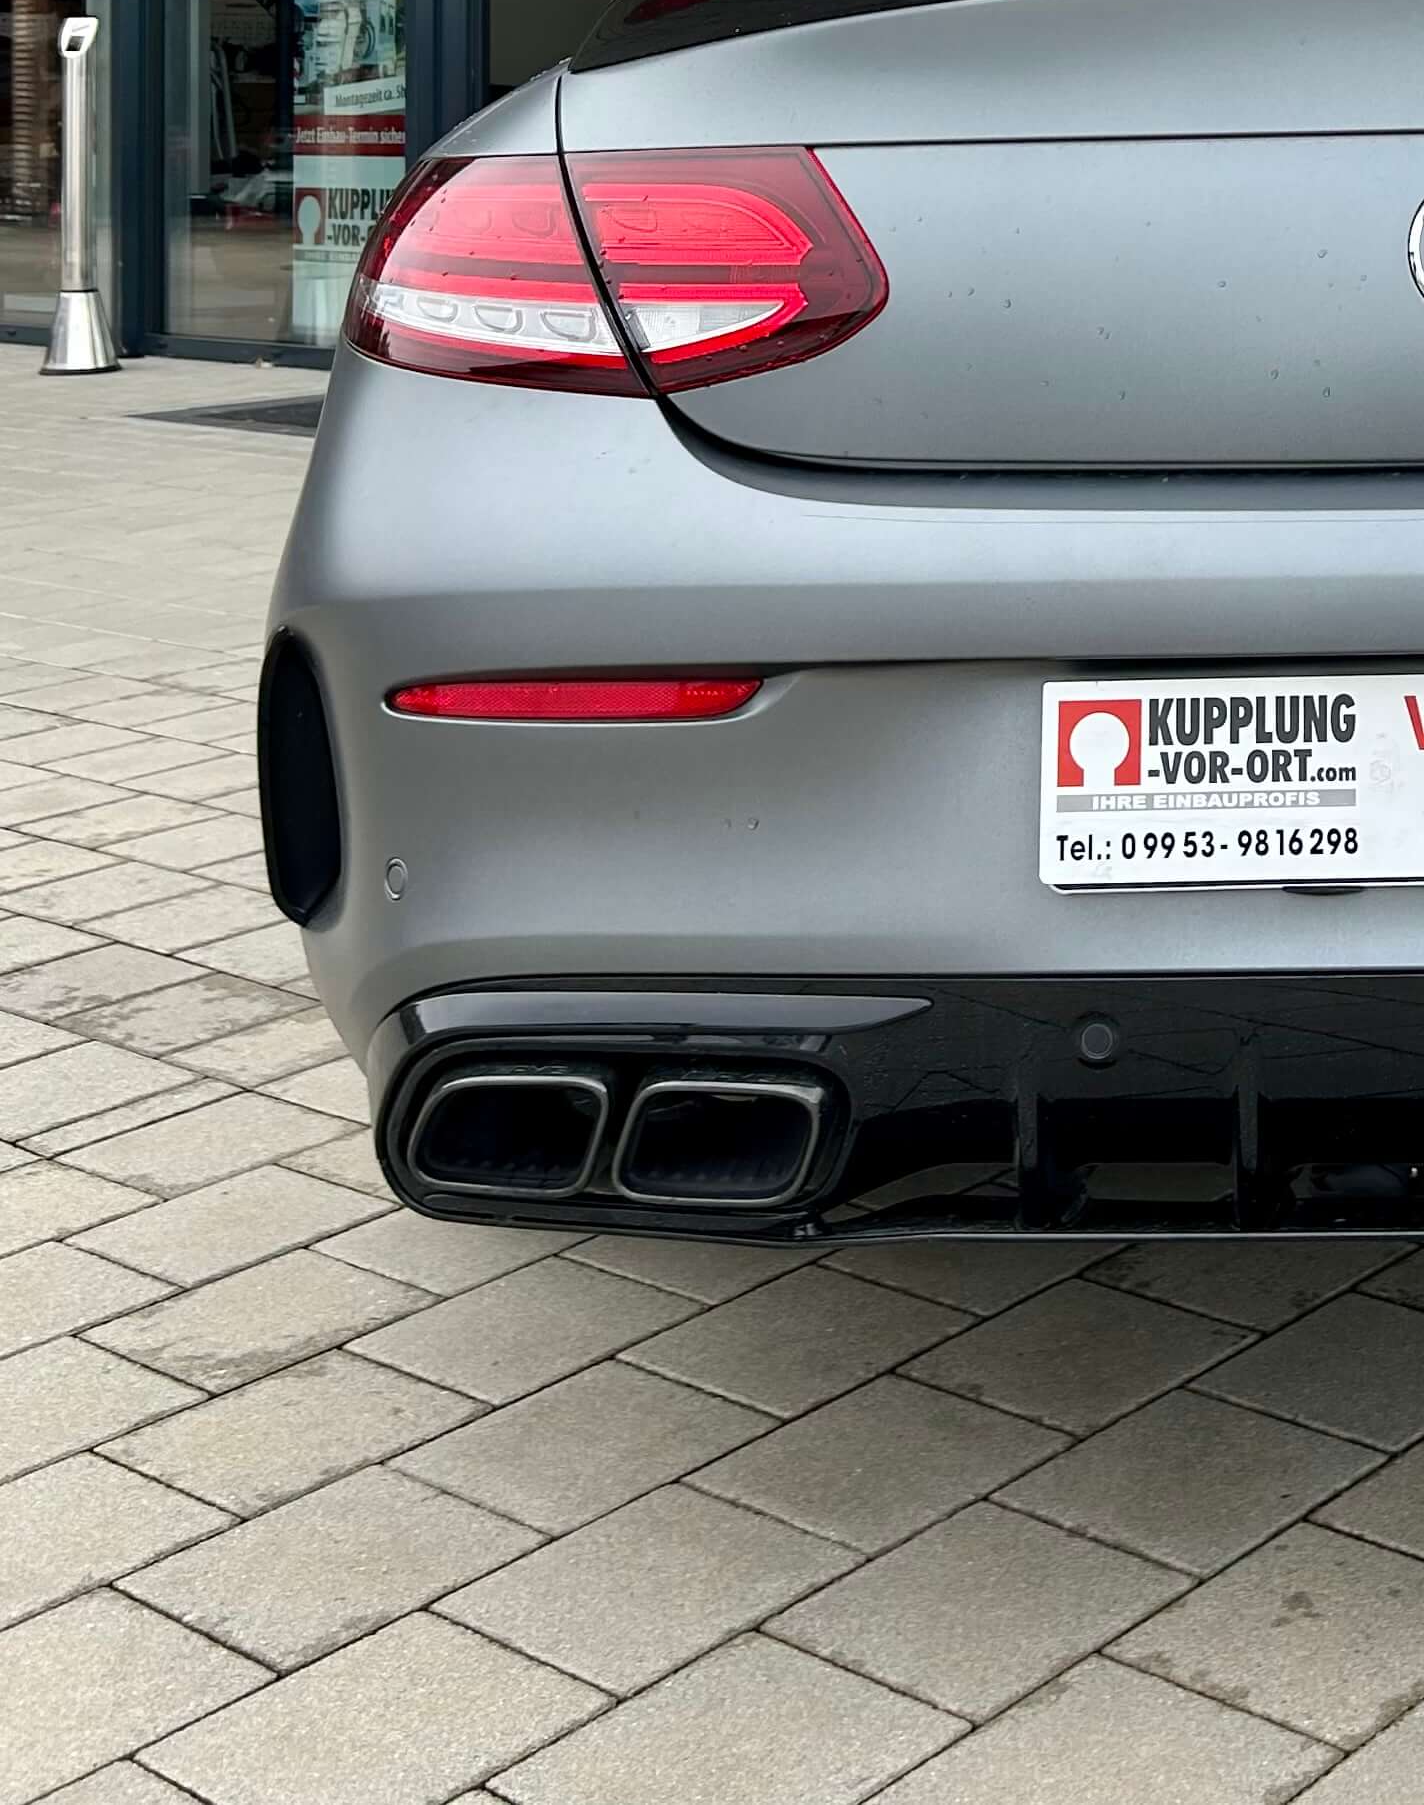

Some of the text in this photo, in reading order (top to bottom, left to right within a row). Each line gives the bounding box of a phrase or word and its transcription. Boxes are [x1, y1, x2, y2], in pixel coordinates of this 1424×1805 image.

[1148, 693, 1356, 747] KUPPLUNG
[1147, 748, 1357, 785] -VOR-ORT.com
[1091, 790, 1321, 811] IHRE EINBAUPROFIS
[1056, 833, 1111, 861] Tel.:
